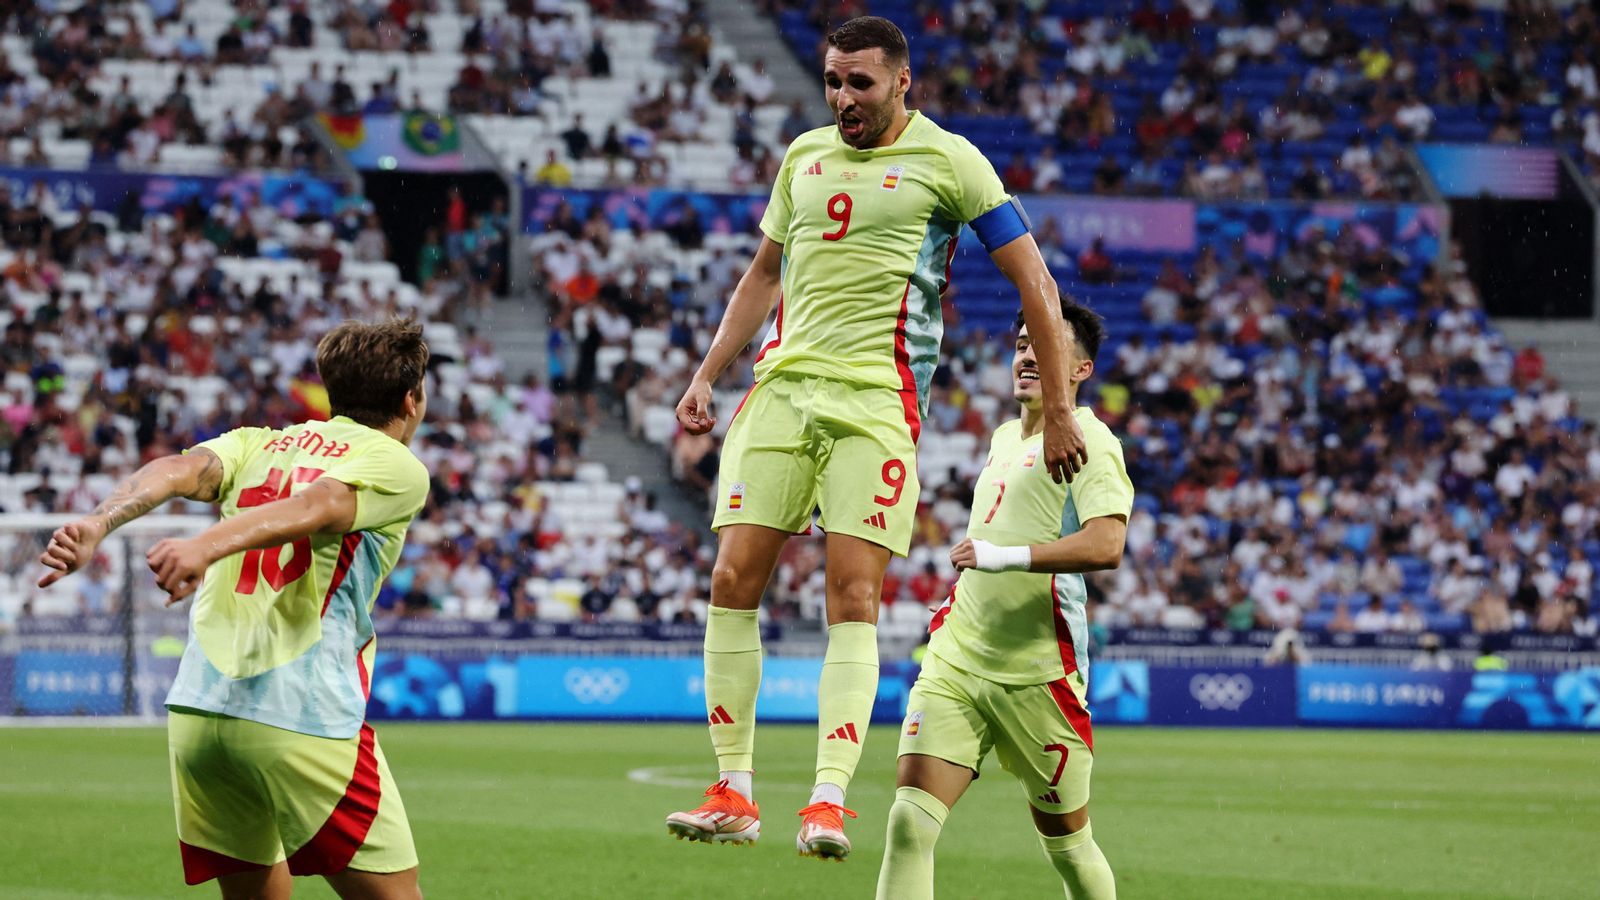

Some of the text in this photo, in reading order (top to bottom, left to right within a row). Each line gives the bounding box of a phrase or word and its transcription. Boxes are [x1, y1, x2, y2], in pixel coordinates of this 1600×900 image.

[822, 192, 853, 241] 9
[873, 458, 906, 507] 9
[984, 479, 1005, 524] 7
[1043, 743, 1069, 787] 7
